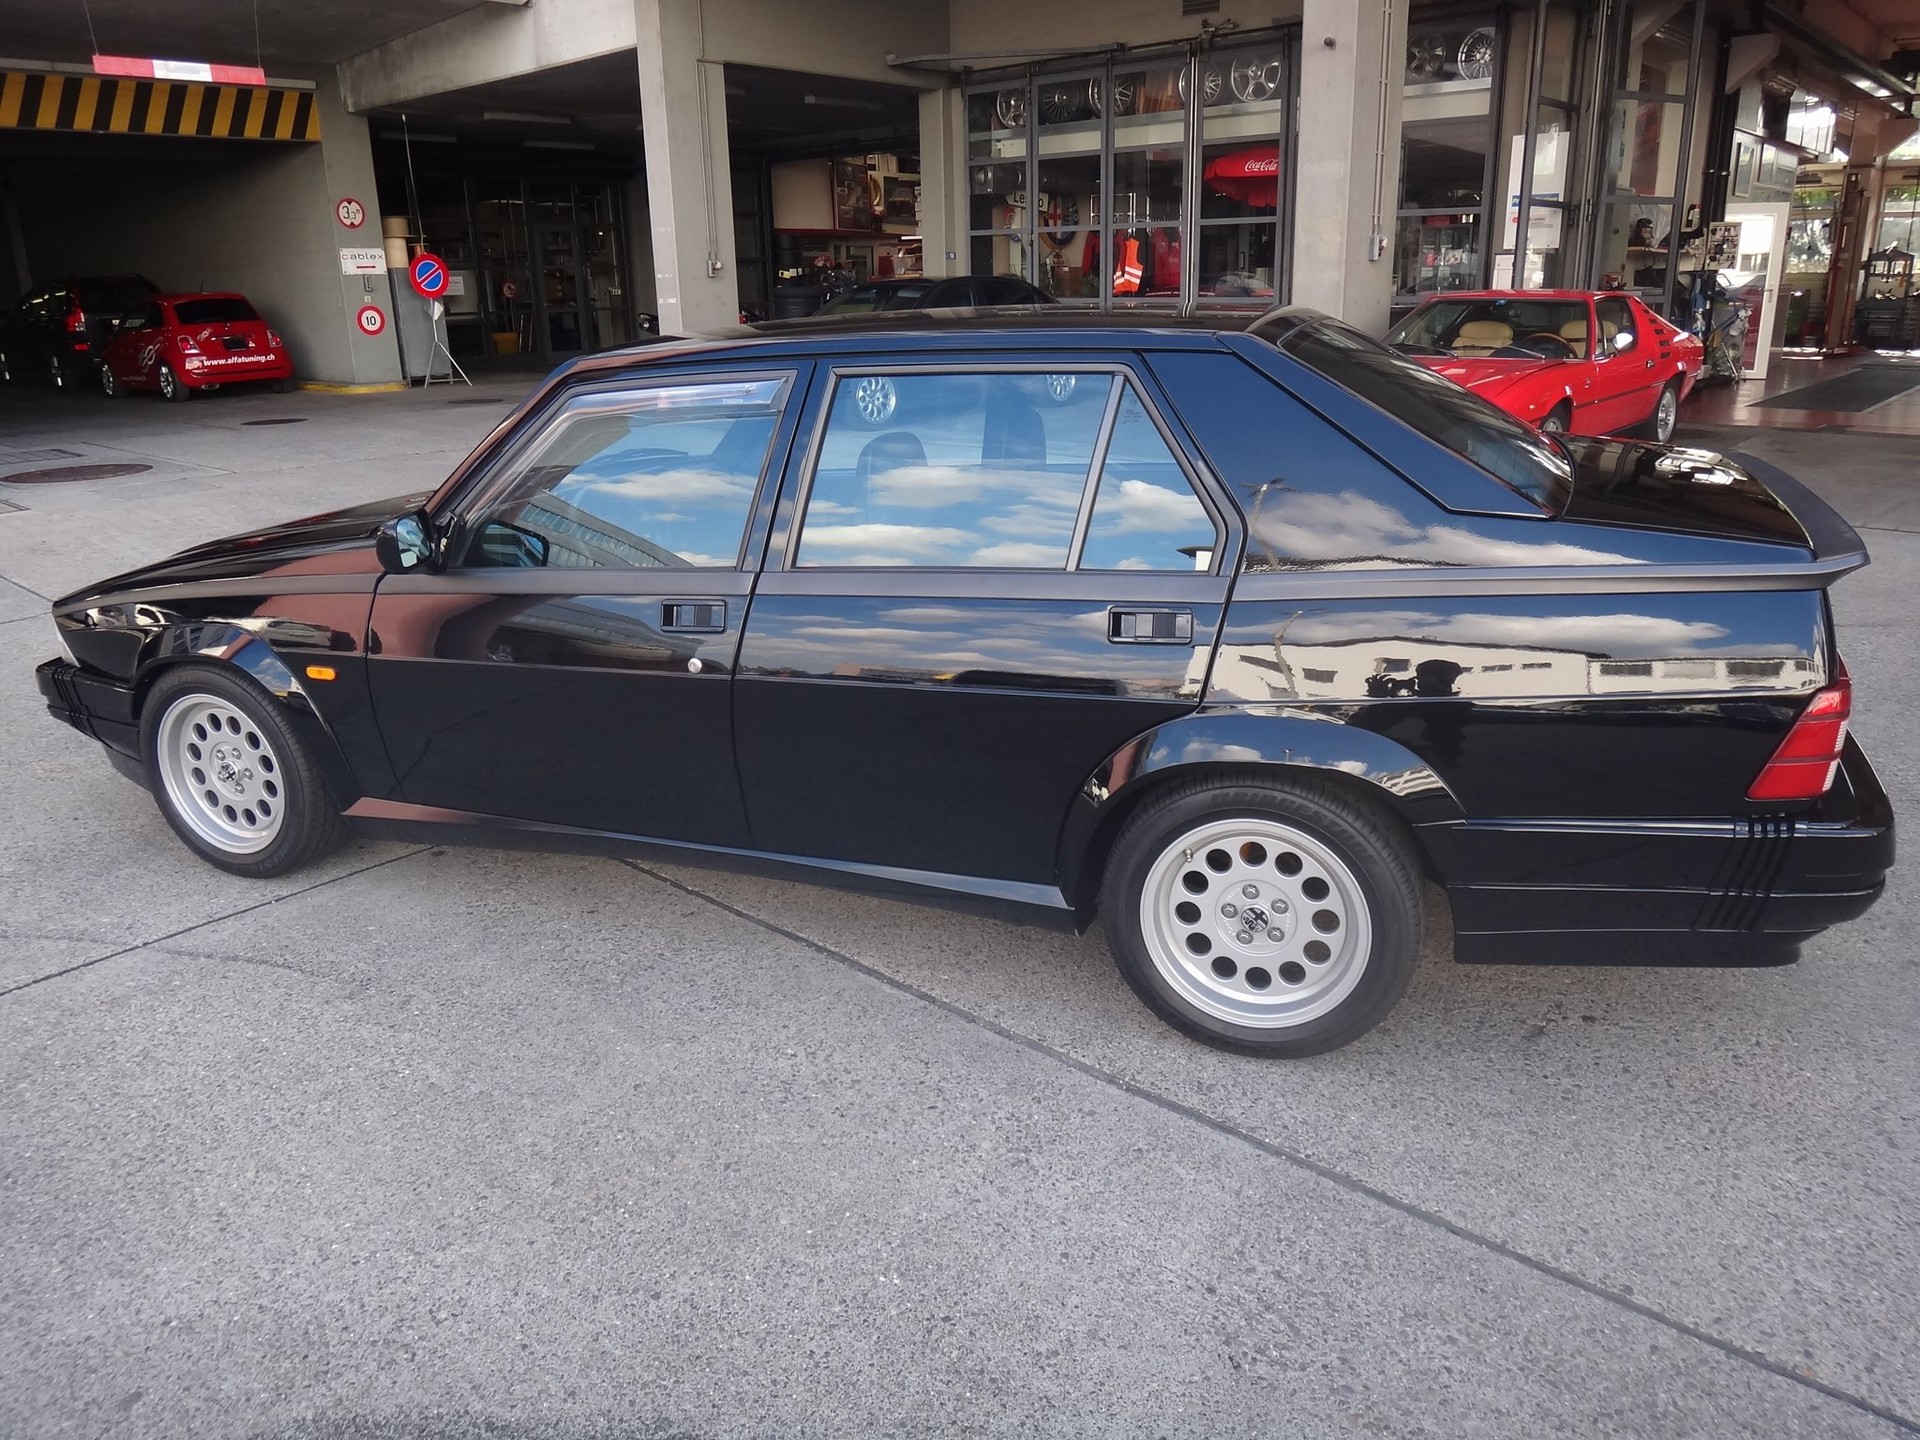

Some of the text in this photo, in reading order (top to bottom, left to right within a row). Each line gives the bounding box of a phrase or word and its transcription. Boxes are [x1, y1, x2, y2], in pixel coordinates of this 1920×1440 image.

[1013, 189, 1044, 208] Leo
[341, 252, 384, 261] cablex
[365, 315, 377, 326] 10
[203, 353, 275, 366] www.alfatuning.ch
